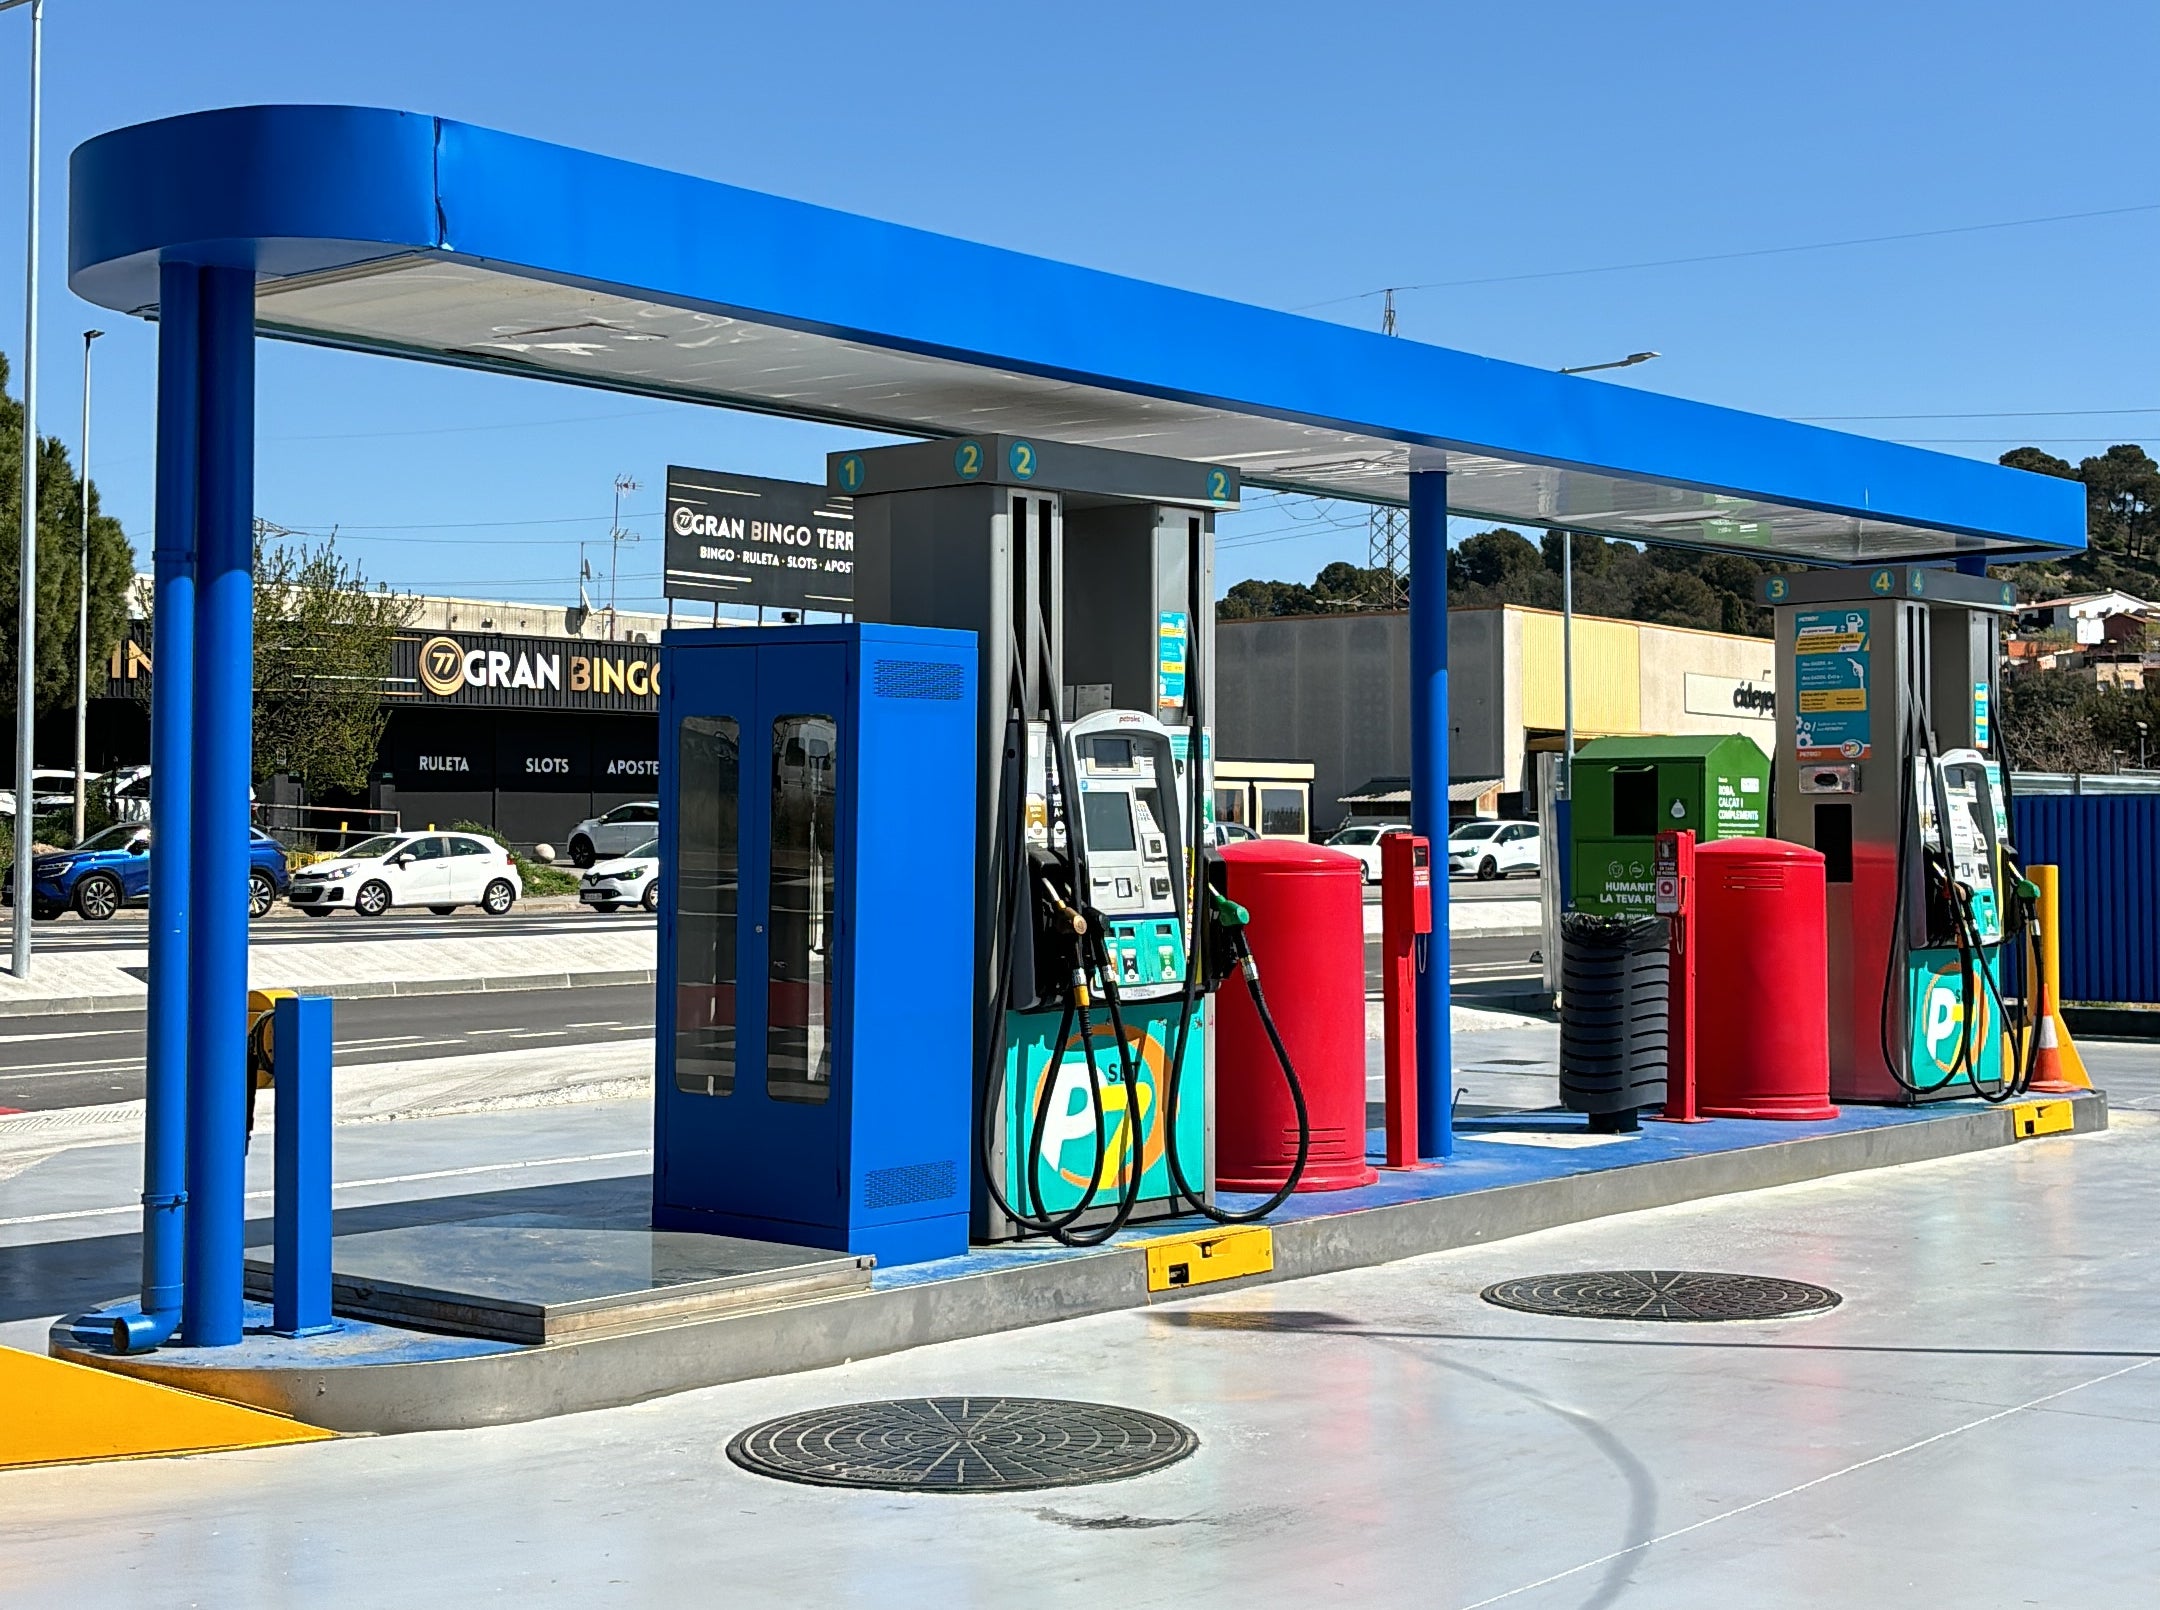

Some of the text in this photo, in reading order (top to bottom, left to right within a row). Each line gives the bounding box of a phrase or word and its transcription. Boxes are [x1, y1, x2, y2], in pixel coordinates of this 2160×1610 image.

[845, 447, 978, 486] 1 2
[1017, 447, 1225, 498] 2 2
[692, 514, 745, 540] GRAN
[751, 520, 811, 547] BINGO
[700, 546, 735, 562] BINGO
[743, 550, 779, 567] RULETA
[787, 556, 818, 570] SLOTS
[1771, 572, 1890, 598] 3 4
[1914, 574, 1921, 592] 4
[432, 652, 456, 675] 77
[462, 650, 560, 691] GRAN
[419, 755, 470, 772] RULETA
[526, 757, 569, 773] SLOTS
[1600, 893, 1613, 903] LA
[1615, 894, 1643, 904] TEVA
[1605, 881, 1656, 892] HUMANIT
